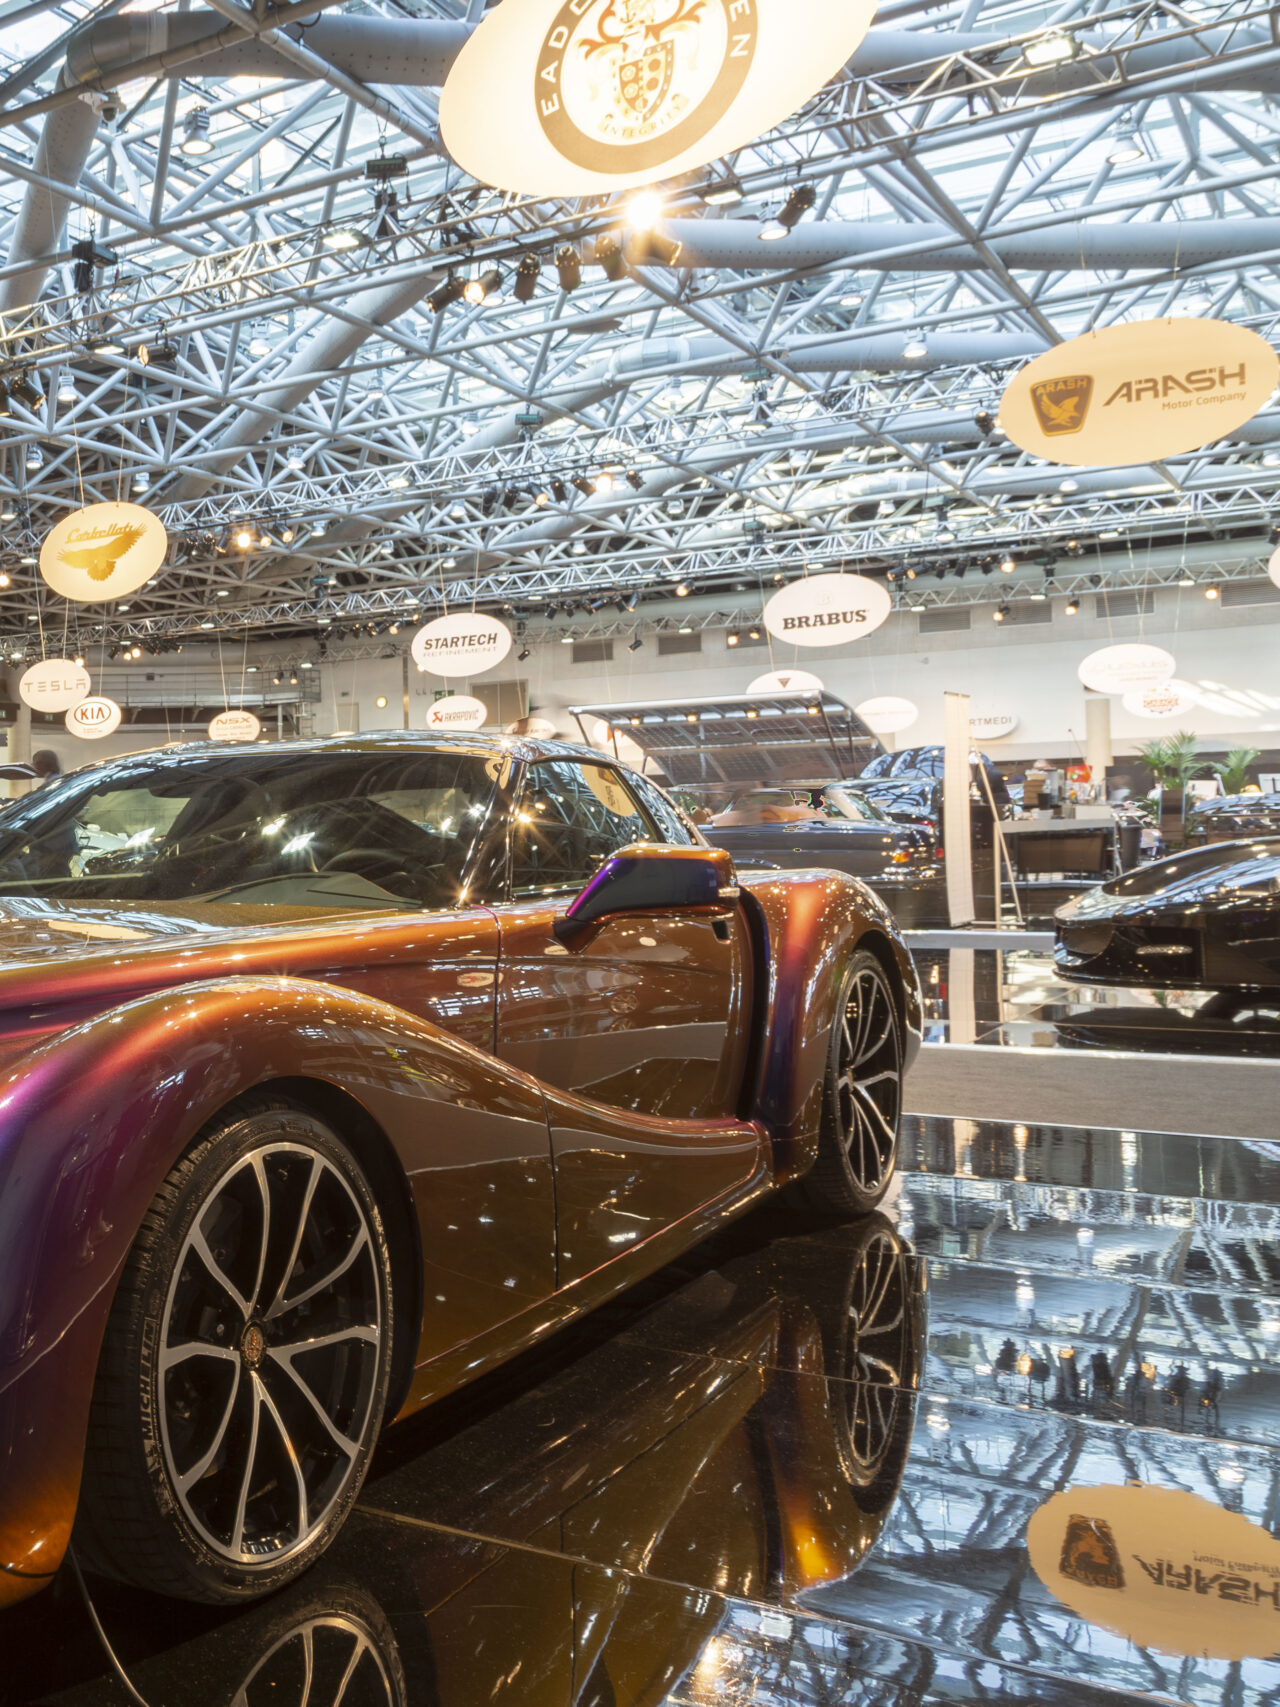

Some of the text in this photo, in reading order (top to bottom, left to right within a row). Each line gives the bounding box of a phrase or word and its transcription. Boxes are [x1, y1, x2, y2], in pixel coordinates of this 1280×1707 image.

[729, 0, 751, 58] EN
[1035, 377, 1088, 397] ARASH
[1102, 362, 1246, 407] ARASH
[1161, 390, 1247, 411] Motor Company
[782, 609, 867, 630] BRABUS
[424, 632, 498, 650] STARTECH
[24, 678, 86, 693] TESLA
[80, 706, 105, 720] KIA
[969, 716, 1012, 726] RTMEDI
